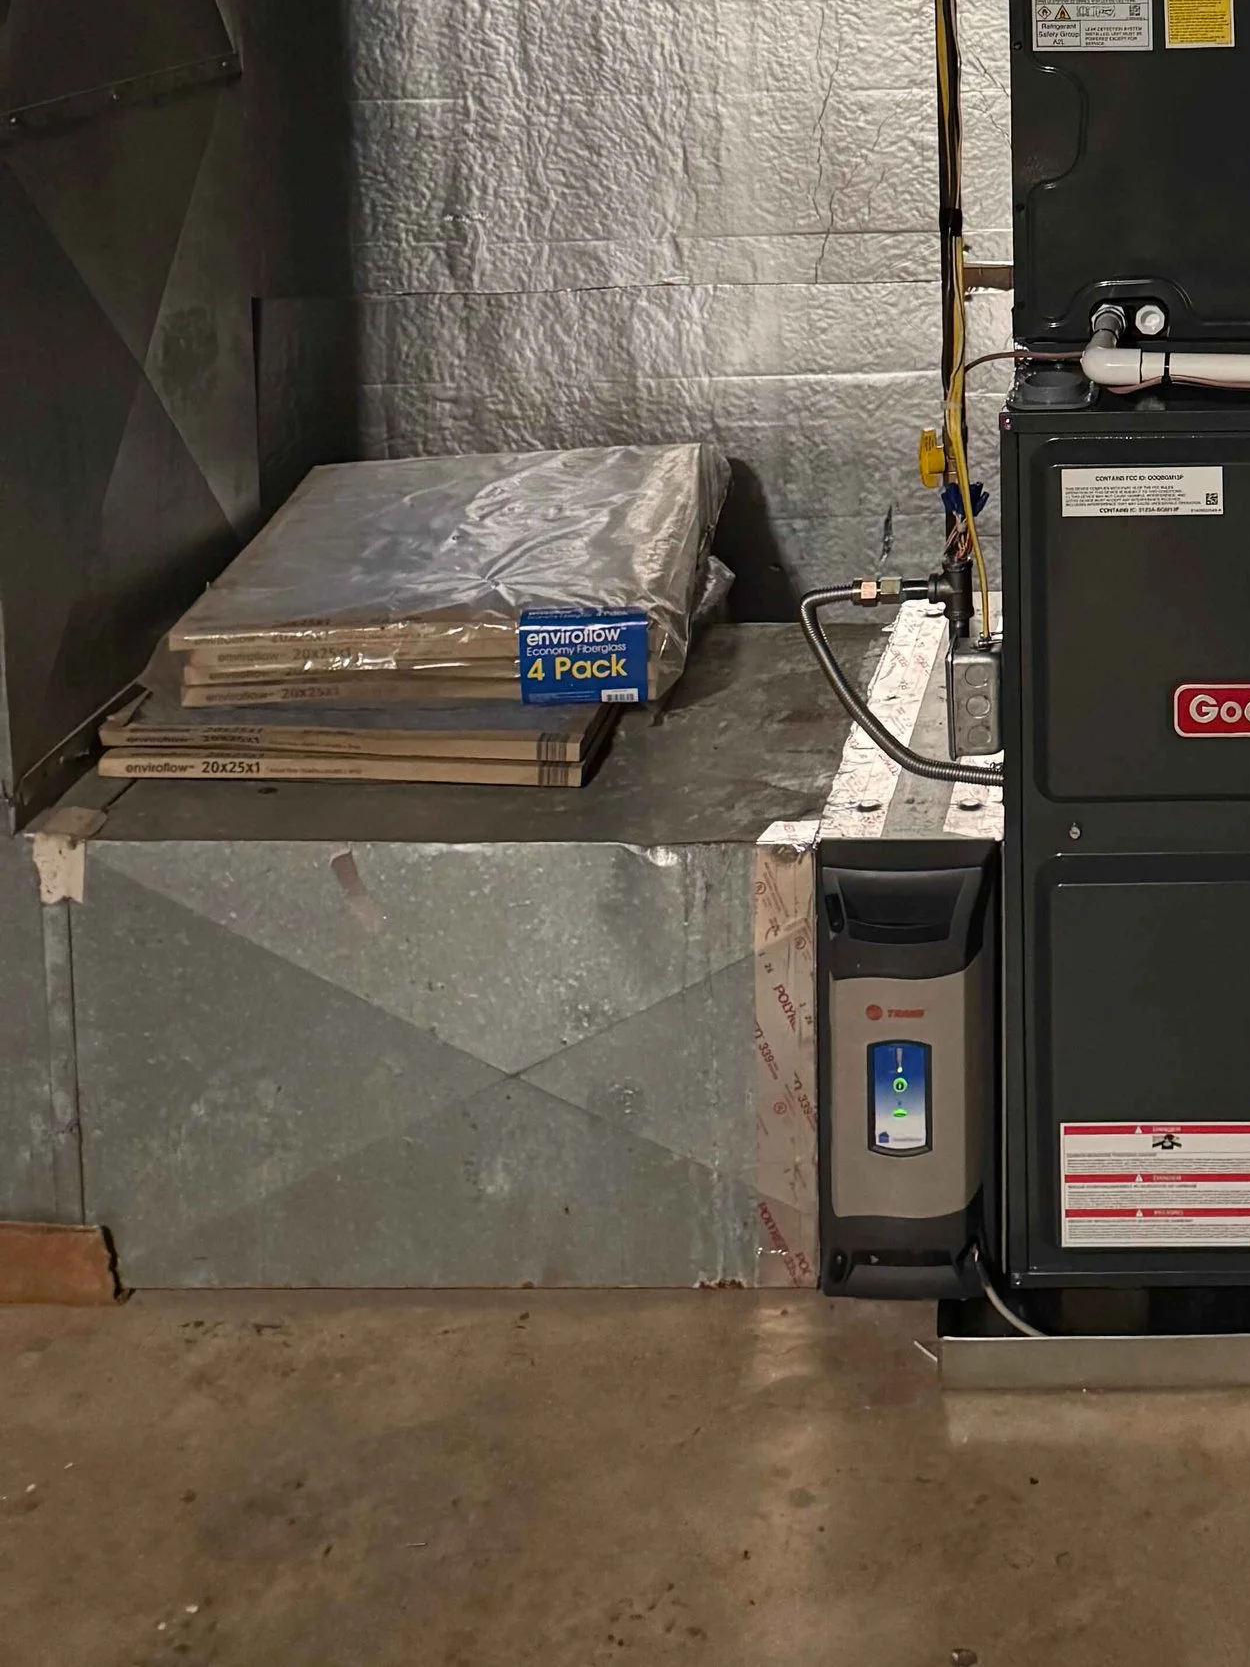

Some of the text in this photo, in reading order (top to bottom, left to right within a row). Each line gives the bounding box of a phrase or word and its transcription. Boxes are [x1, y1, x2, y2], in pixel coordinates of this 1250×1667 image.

[1042, 23, 1076, 31] Refrigerant
[1038, 31, 1058, 39] Safety
[526, 643, 627, 656] Economy Fiberglass
[526, 654, 628, 681] 4 Pack
[281, 686, 339, 700] 20x25x1
[201, 761, 261, 774] 20x25x1
